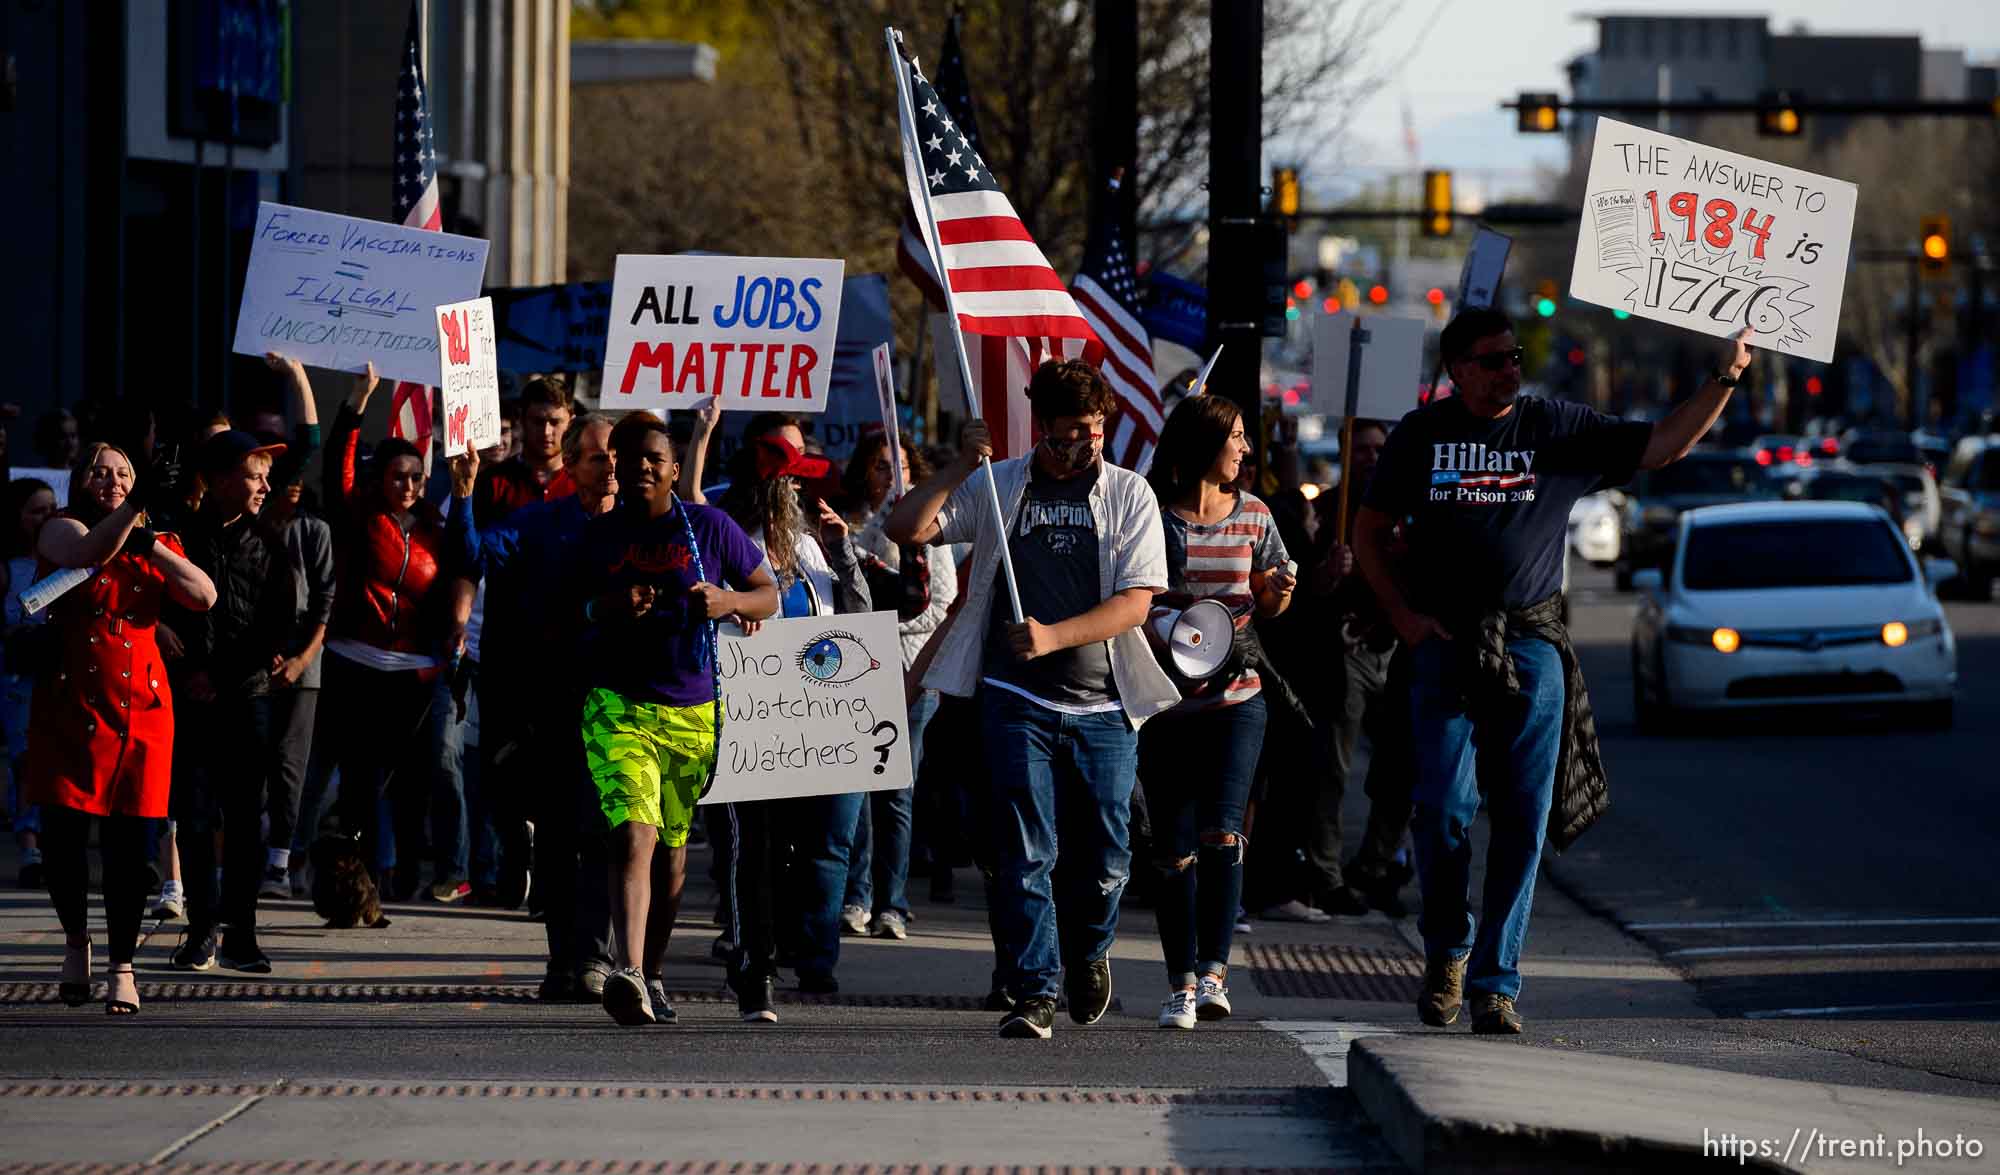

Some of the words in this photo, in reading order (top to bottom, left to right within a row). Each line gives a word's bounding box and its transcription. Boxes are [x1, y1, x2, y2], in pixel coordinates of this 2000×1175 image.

[1614, 143, 1672, 176] THE
[1683, 154, 1784, 204] ANSWER
[1795, 185, 1826, 213] TO
[340, 222, 477, 263] VACCINATIONS
[1644, 190, 1776, 263] 1984
[1786, 232, 1824, 265] is
[285, 276, 417, 312] ILLEGAL
[630, 285, 700, 326] ALL
[713, 275, 824, 333] JOBS
[1644, 256, 1785, 335] 1776
[441, 309, 470, 367] YOU
[619, 342, 819, 399] MATTER
[448, 403, 468, 449] MY
[1431, 442, 1536, 480] Hillary
[1429, 487, 1452, 502] for
[1456, 487, 1507, 503] Prison
[1510, 488, 1536, 502] 2016
[726, 687, 876, 734] Watching
[729, 733, 858, 775] Watchers
